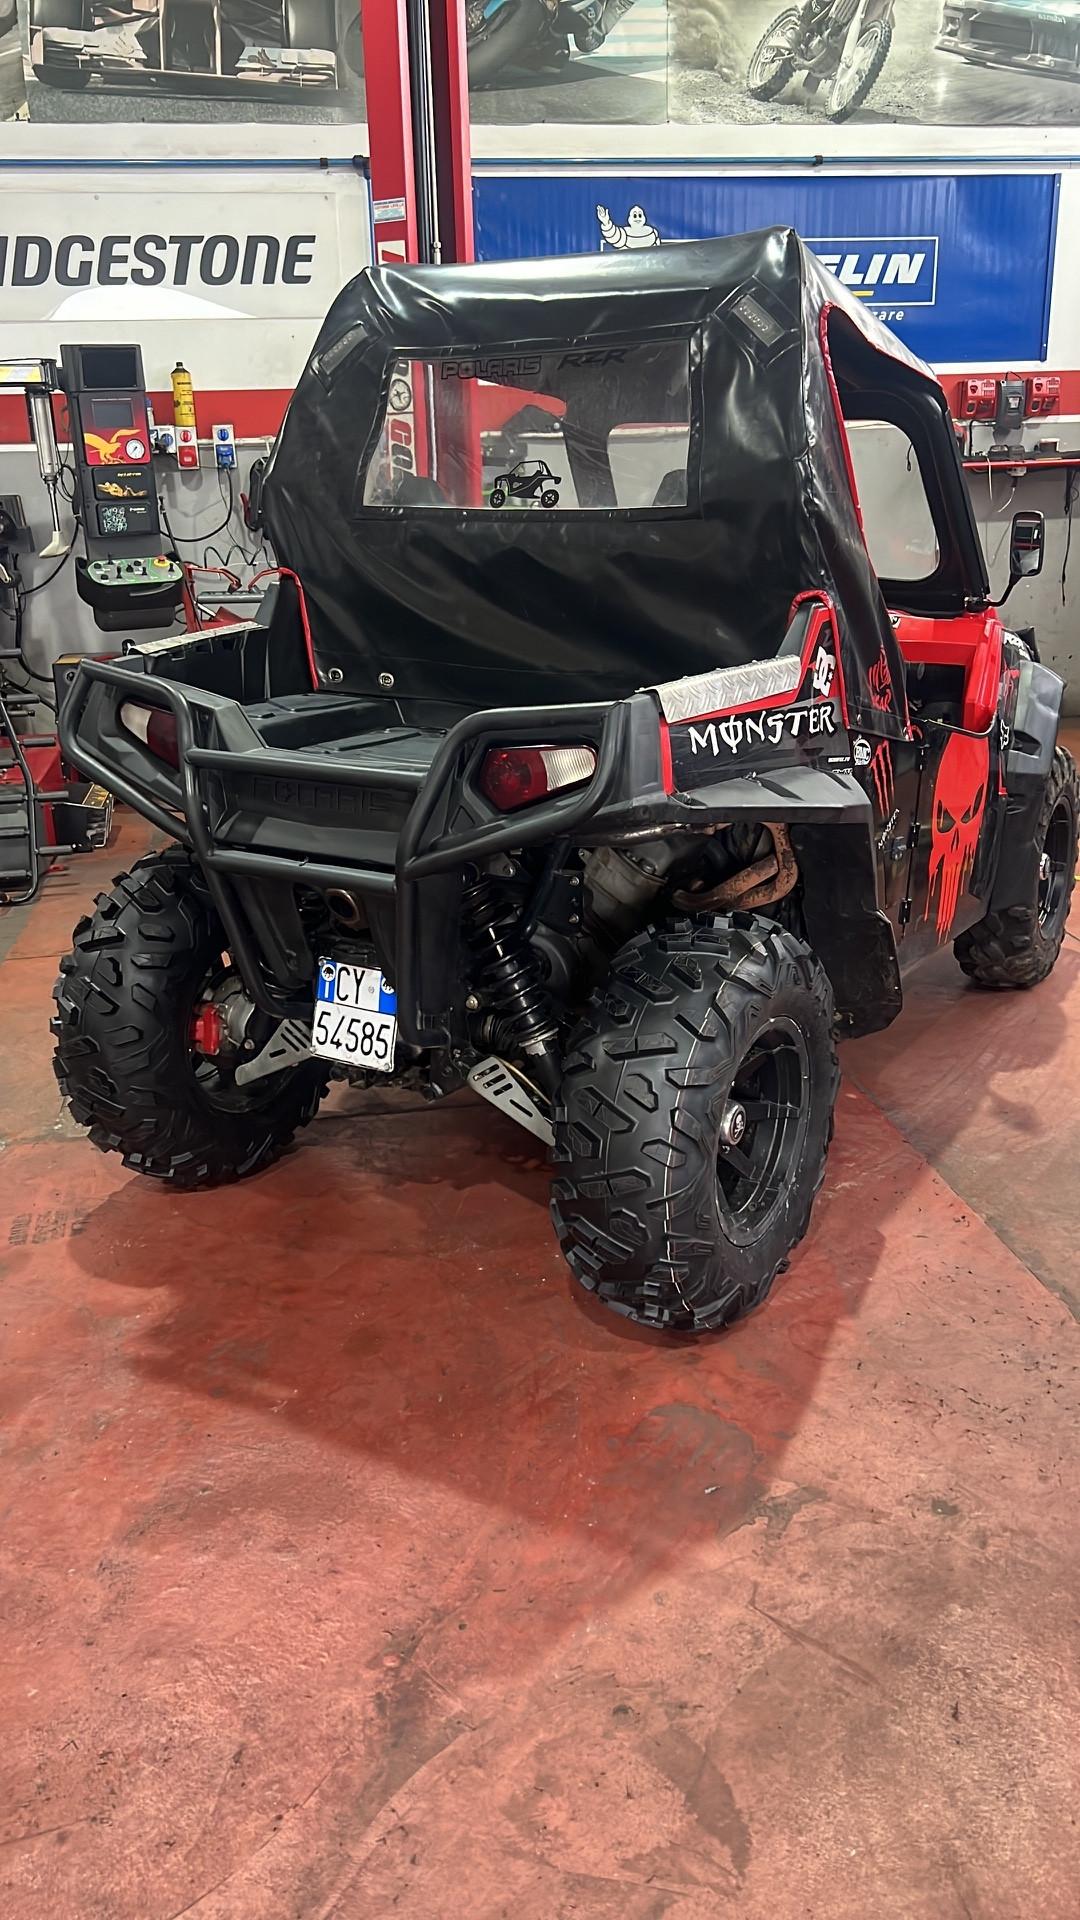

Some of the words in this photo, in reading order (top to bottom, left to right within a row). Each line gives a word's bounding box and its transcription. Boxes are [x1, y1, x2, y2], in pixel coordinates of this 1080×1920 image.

[441, 355, 542, 380] POLARIS
[557, 351, 628, 371] RZR
[687, 704, 835, 757] MONSTER
[336, 966, 366, 1005] CY
[315, 1010, 391, 1059] 54585
